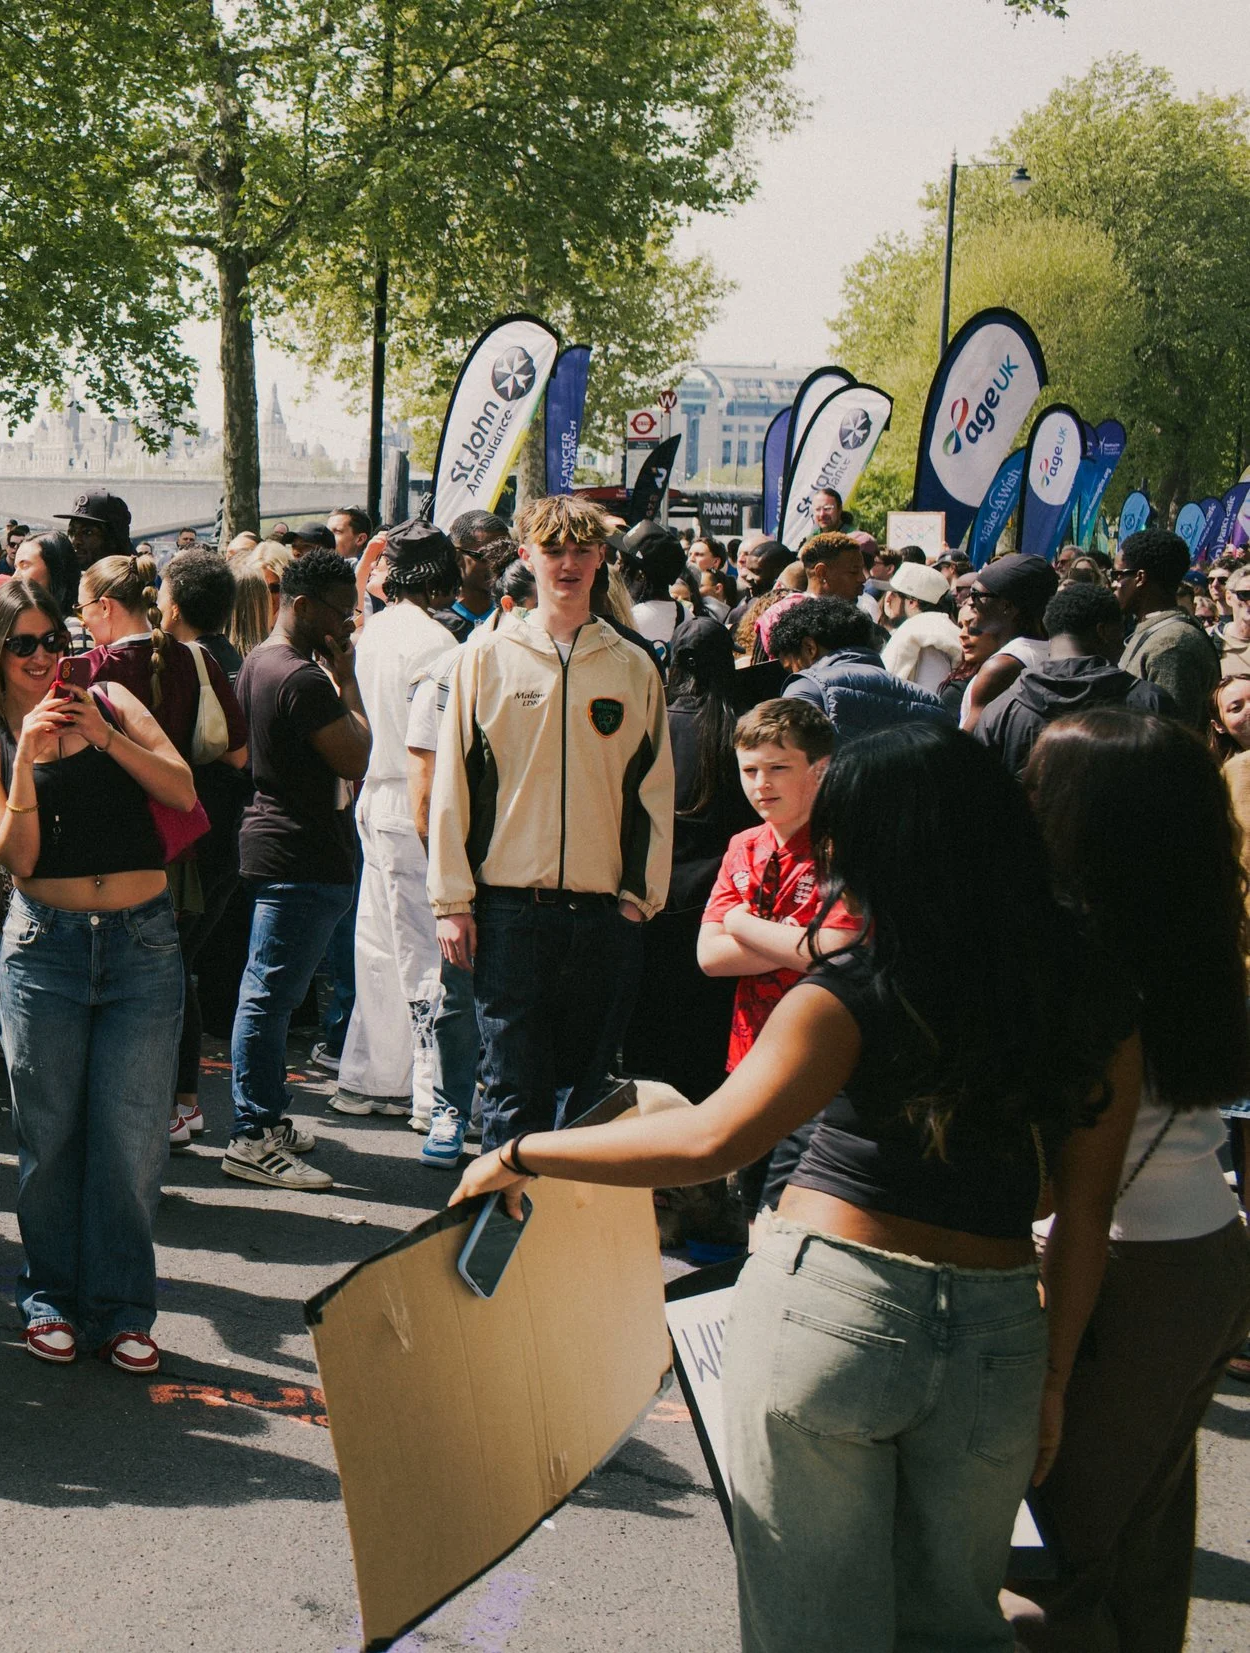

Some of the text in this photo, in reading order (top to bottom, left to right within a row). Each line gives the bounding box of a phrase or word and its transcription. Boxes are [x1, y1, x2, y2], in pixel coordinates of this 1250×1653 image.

[659, 395, 676, 408] W
[965, 354, 1019, 444] age UK
[450, 400, 500, 485] St John
[466, 409, 512, 496] Ambulance
[560, 432, 571, 488] CANCER
[1049, 446, 1063, 478] age
[797, 496, 813, 518] St
